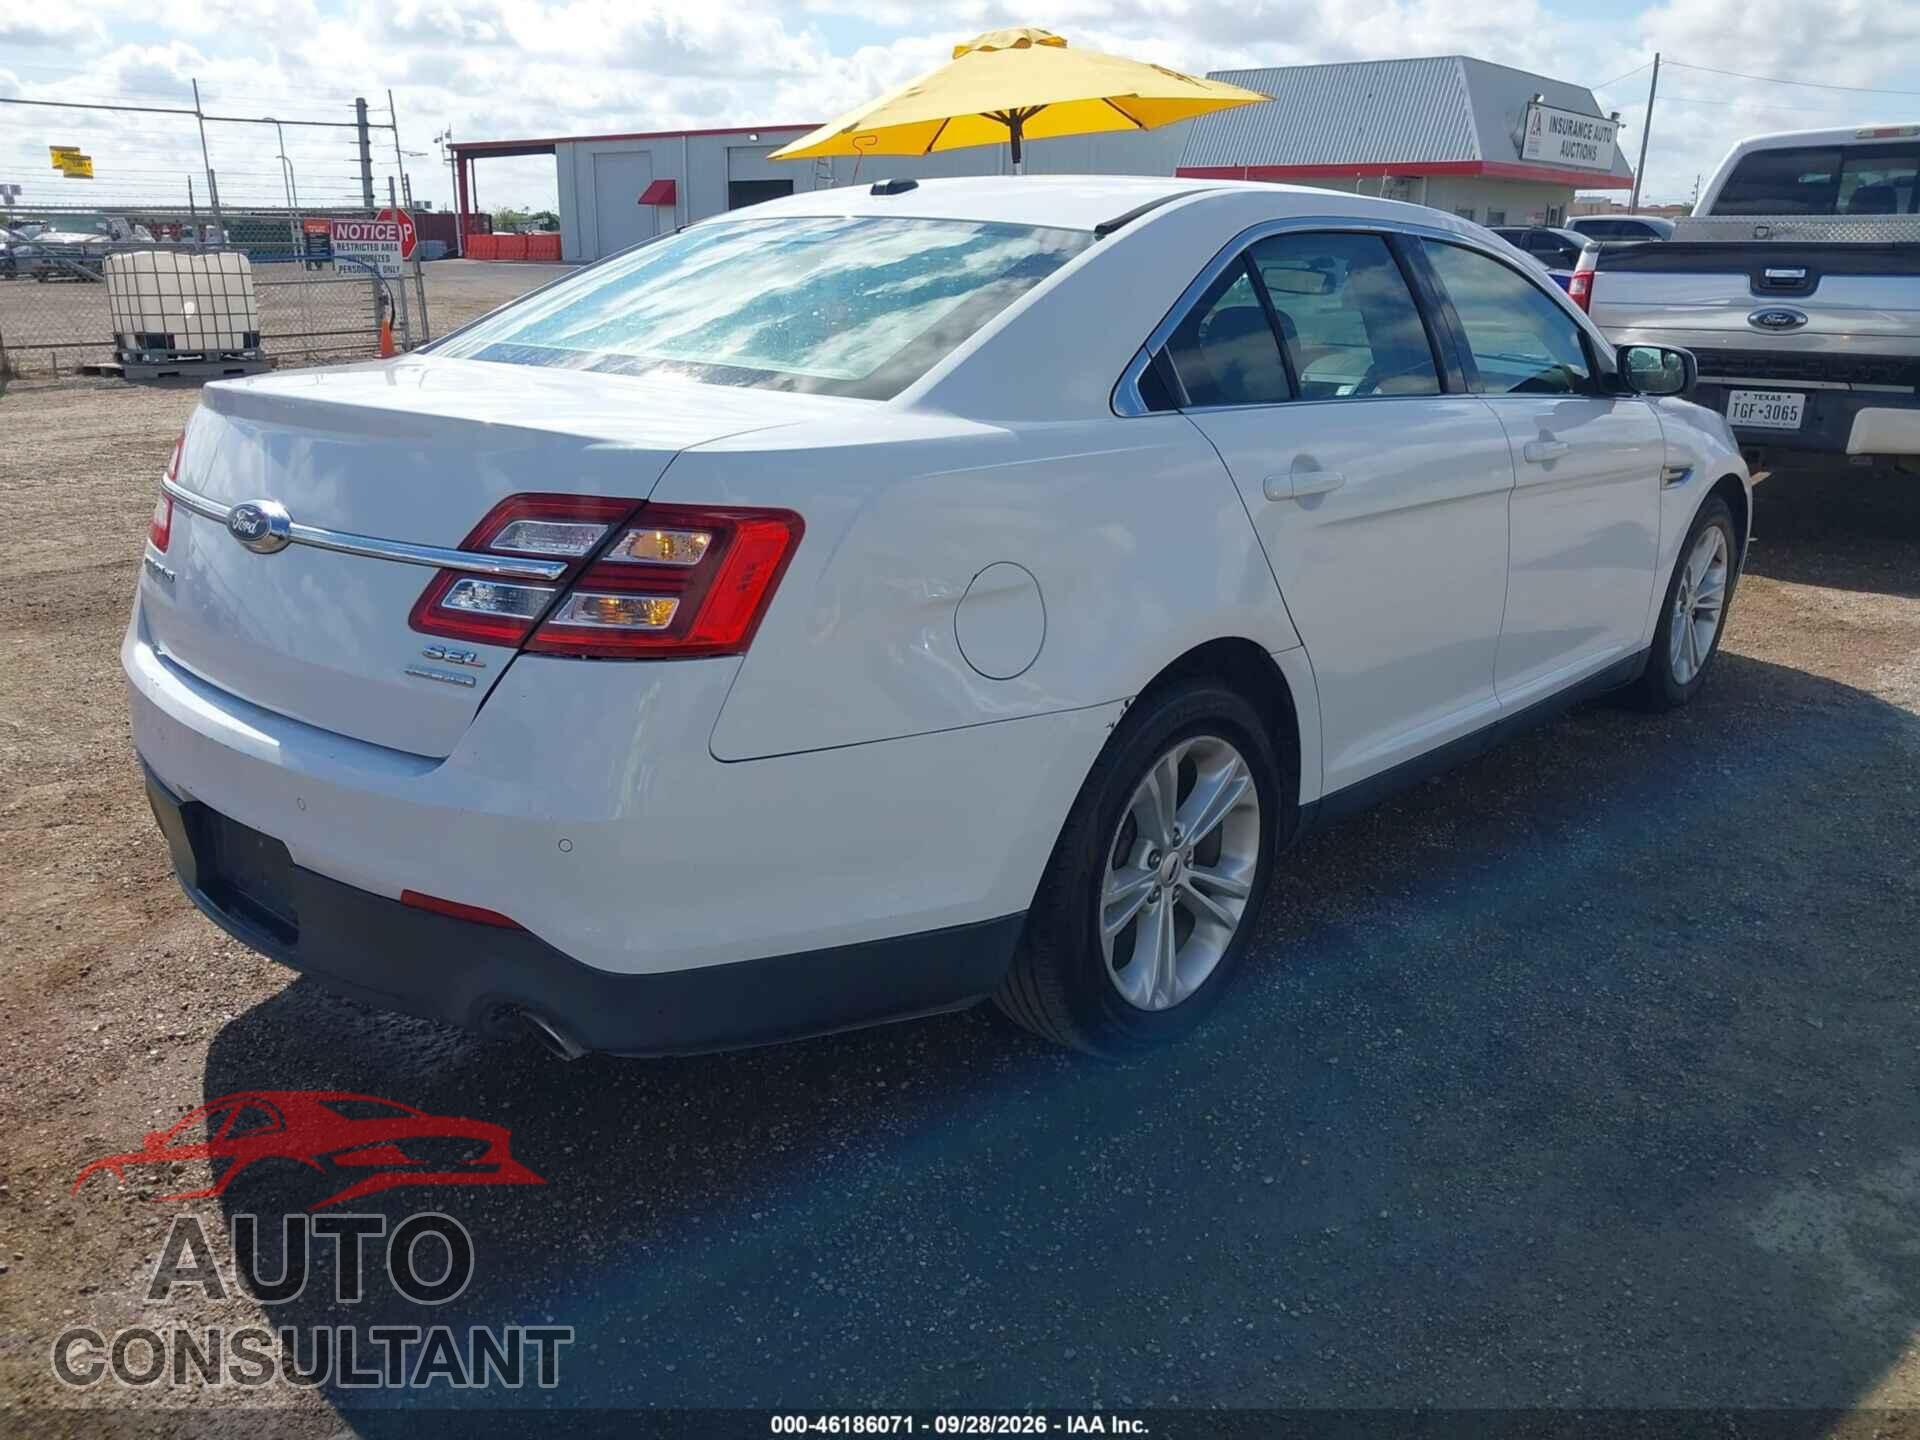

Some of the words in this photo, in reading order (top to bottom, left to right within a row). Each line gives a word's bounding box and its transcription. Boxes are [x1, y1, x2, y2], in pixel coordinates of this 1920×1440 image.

[1549, 115, 1593, 140] INSURANCE
[1593, 125, 1613, 144] AUTO
[1560, 139, 1598, 161] AUCTIONS
[336, 223, 397, 240] NOTICE
[337, 242, 379, 252] RESTRICTED
[381, 242, 398, 252] AREA
[1763, 313, 1789, 325] Ford
[1753, 393, 1781, 401] TEXAS
[232, 508, 260, 535] Ford
